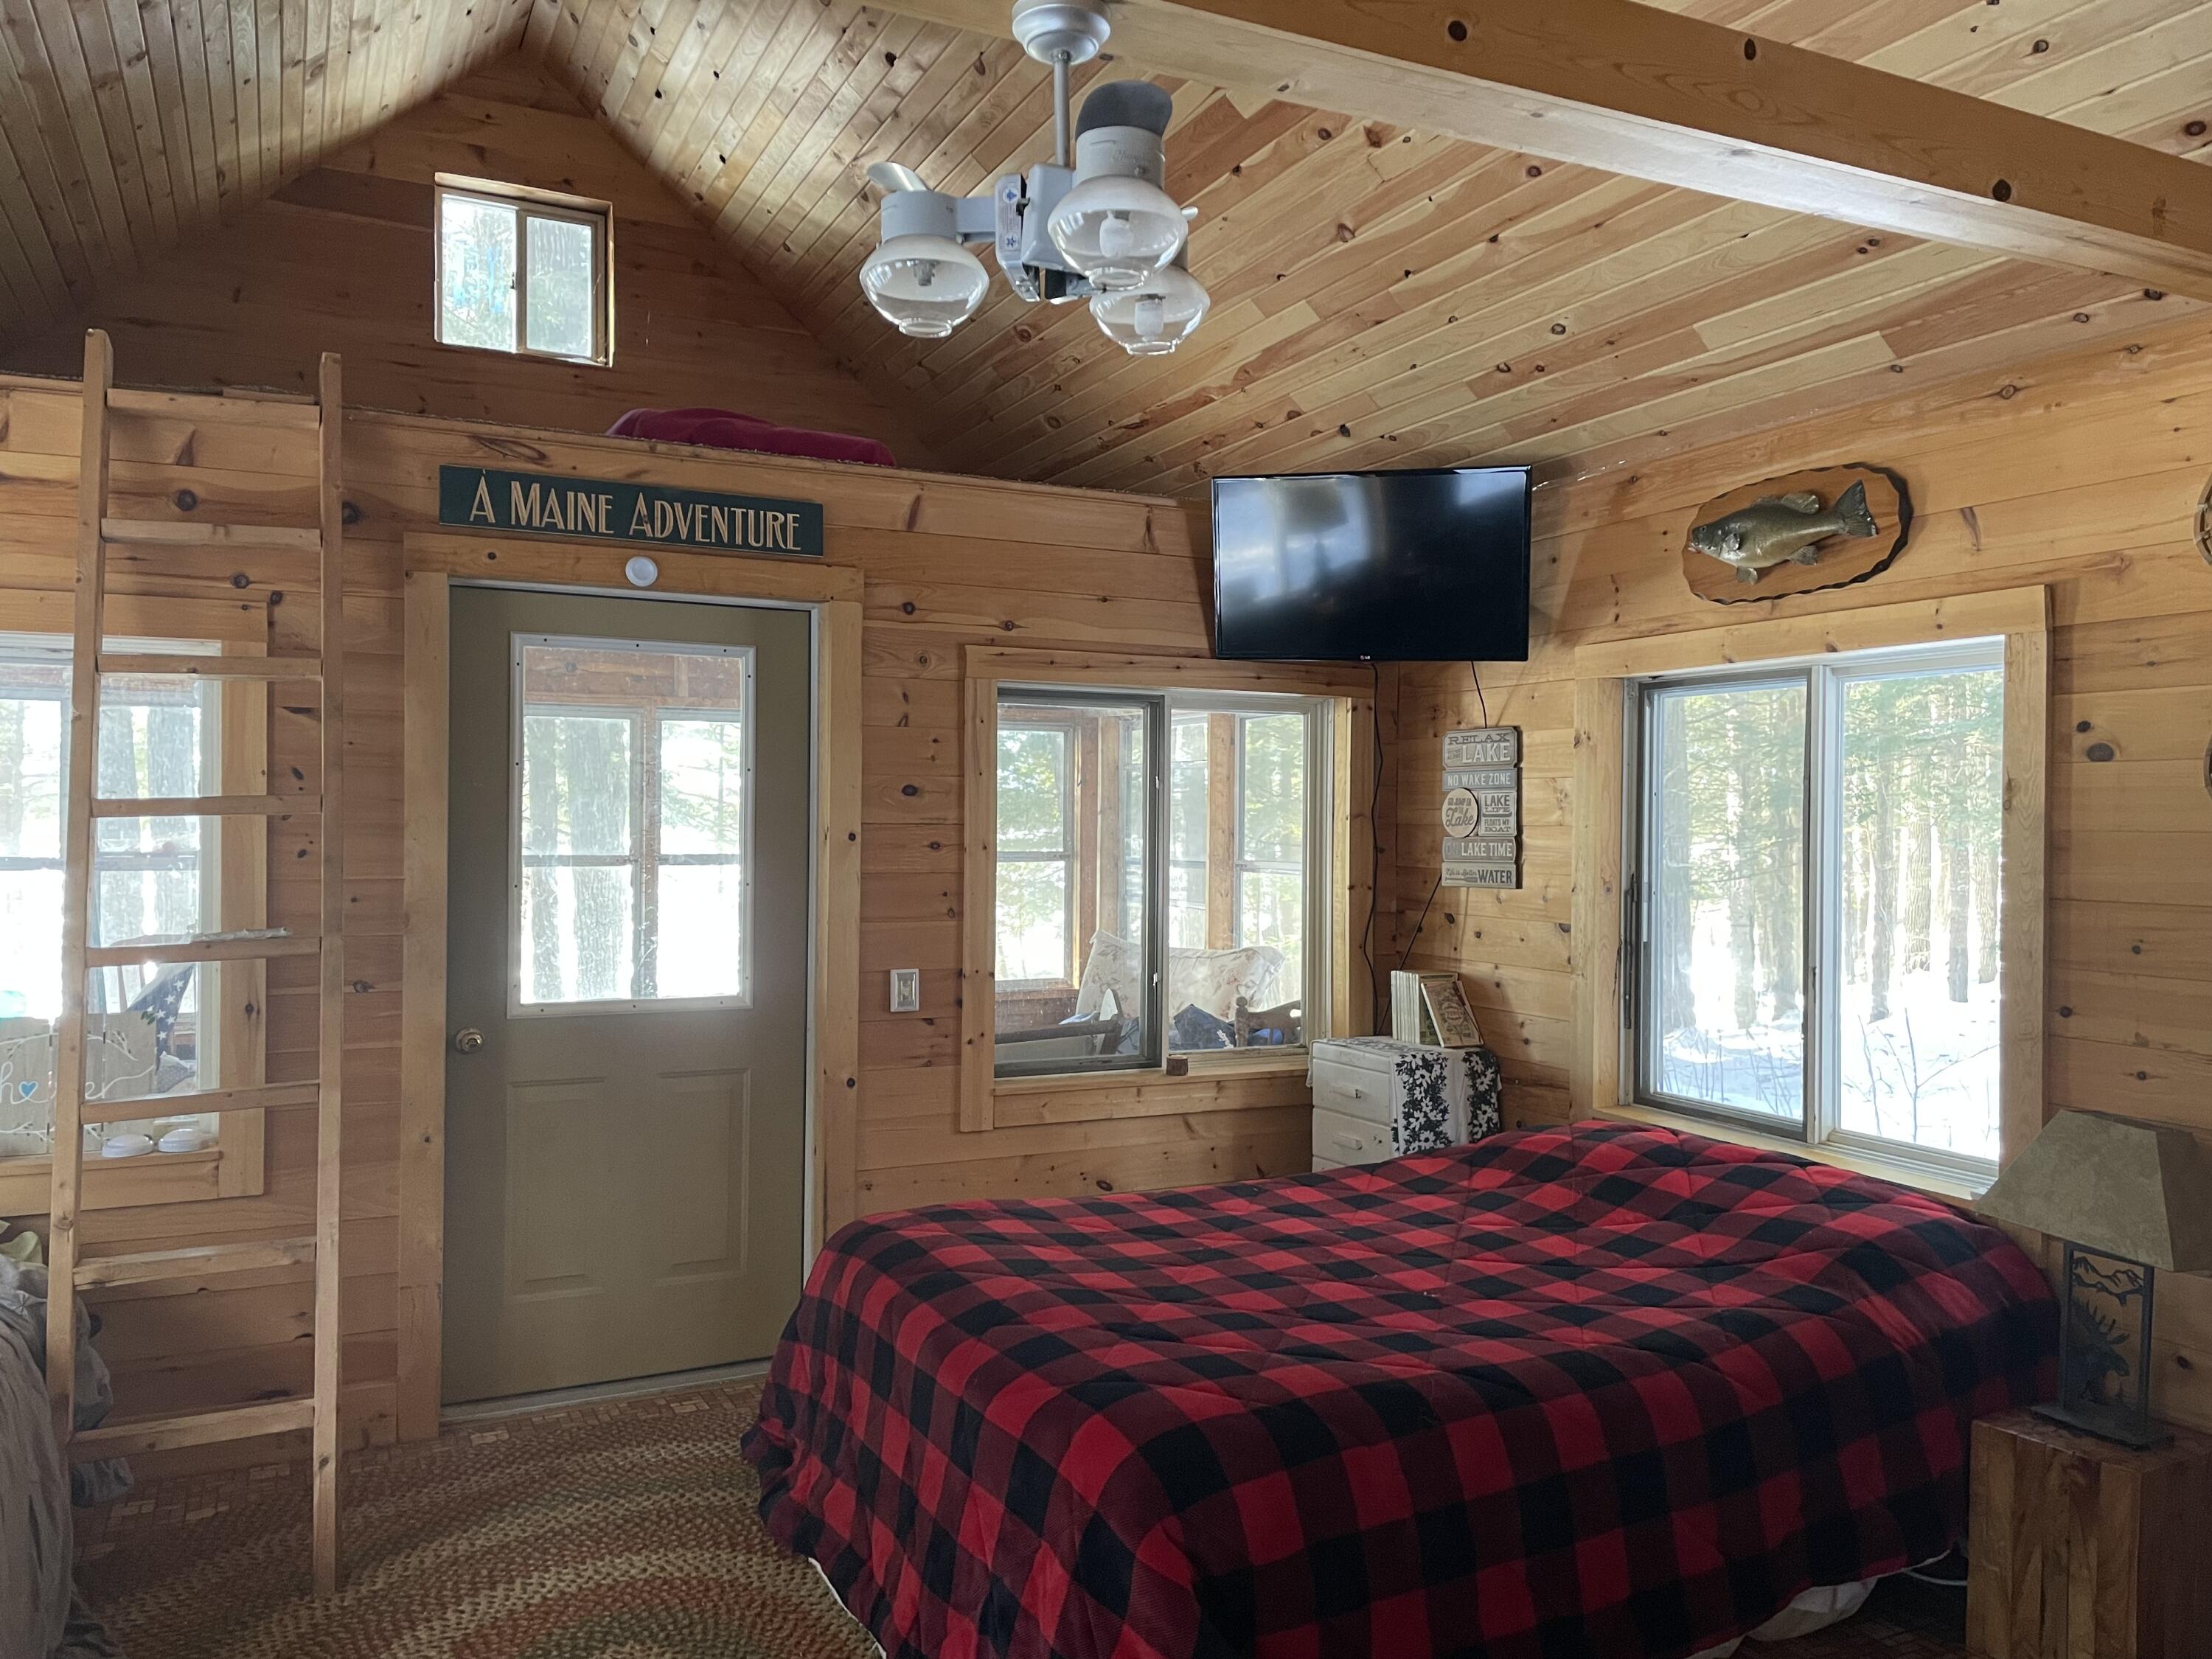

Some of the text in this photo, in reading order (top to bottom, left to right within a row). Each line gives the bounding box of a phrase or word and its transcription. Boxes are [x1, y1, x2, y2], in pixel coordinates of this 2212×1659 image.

[470, 476, 801, 551] A MAINE ADVENTURE
[1447, 733, 1510, 745] RELAX
[1462, 742, 1511, 762] LAKE
[1447, 773, 1511, 786] NO WAKE ZONE
[1484, 795, 1510, 807] LAKE
[1446, 807, 1475, 827] Lake
[1485, 818, 1501, 827] FLOATS
[1461, 842, 1486, 856] LAKE
[1489, 843, 1513, 856] TIME
[1478, 869, 1512, 883] WATER
